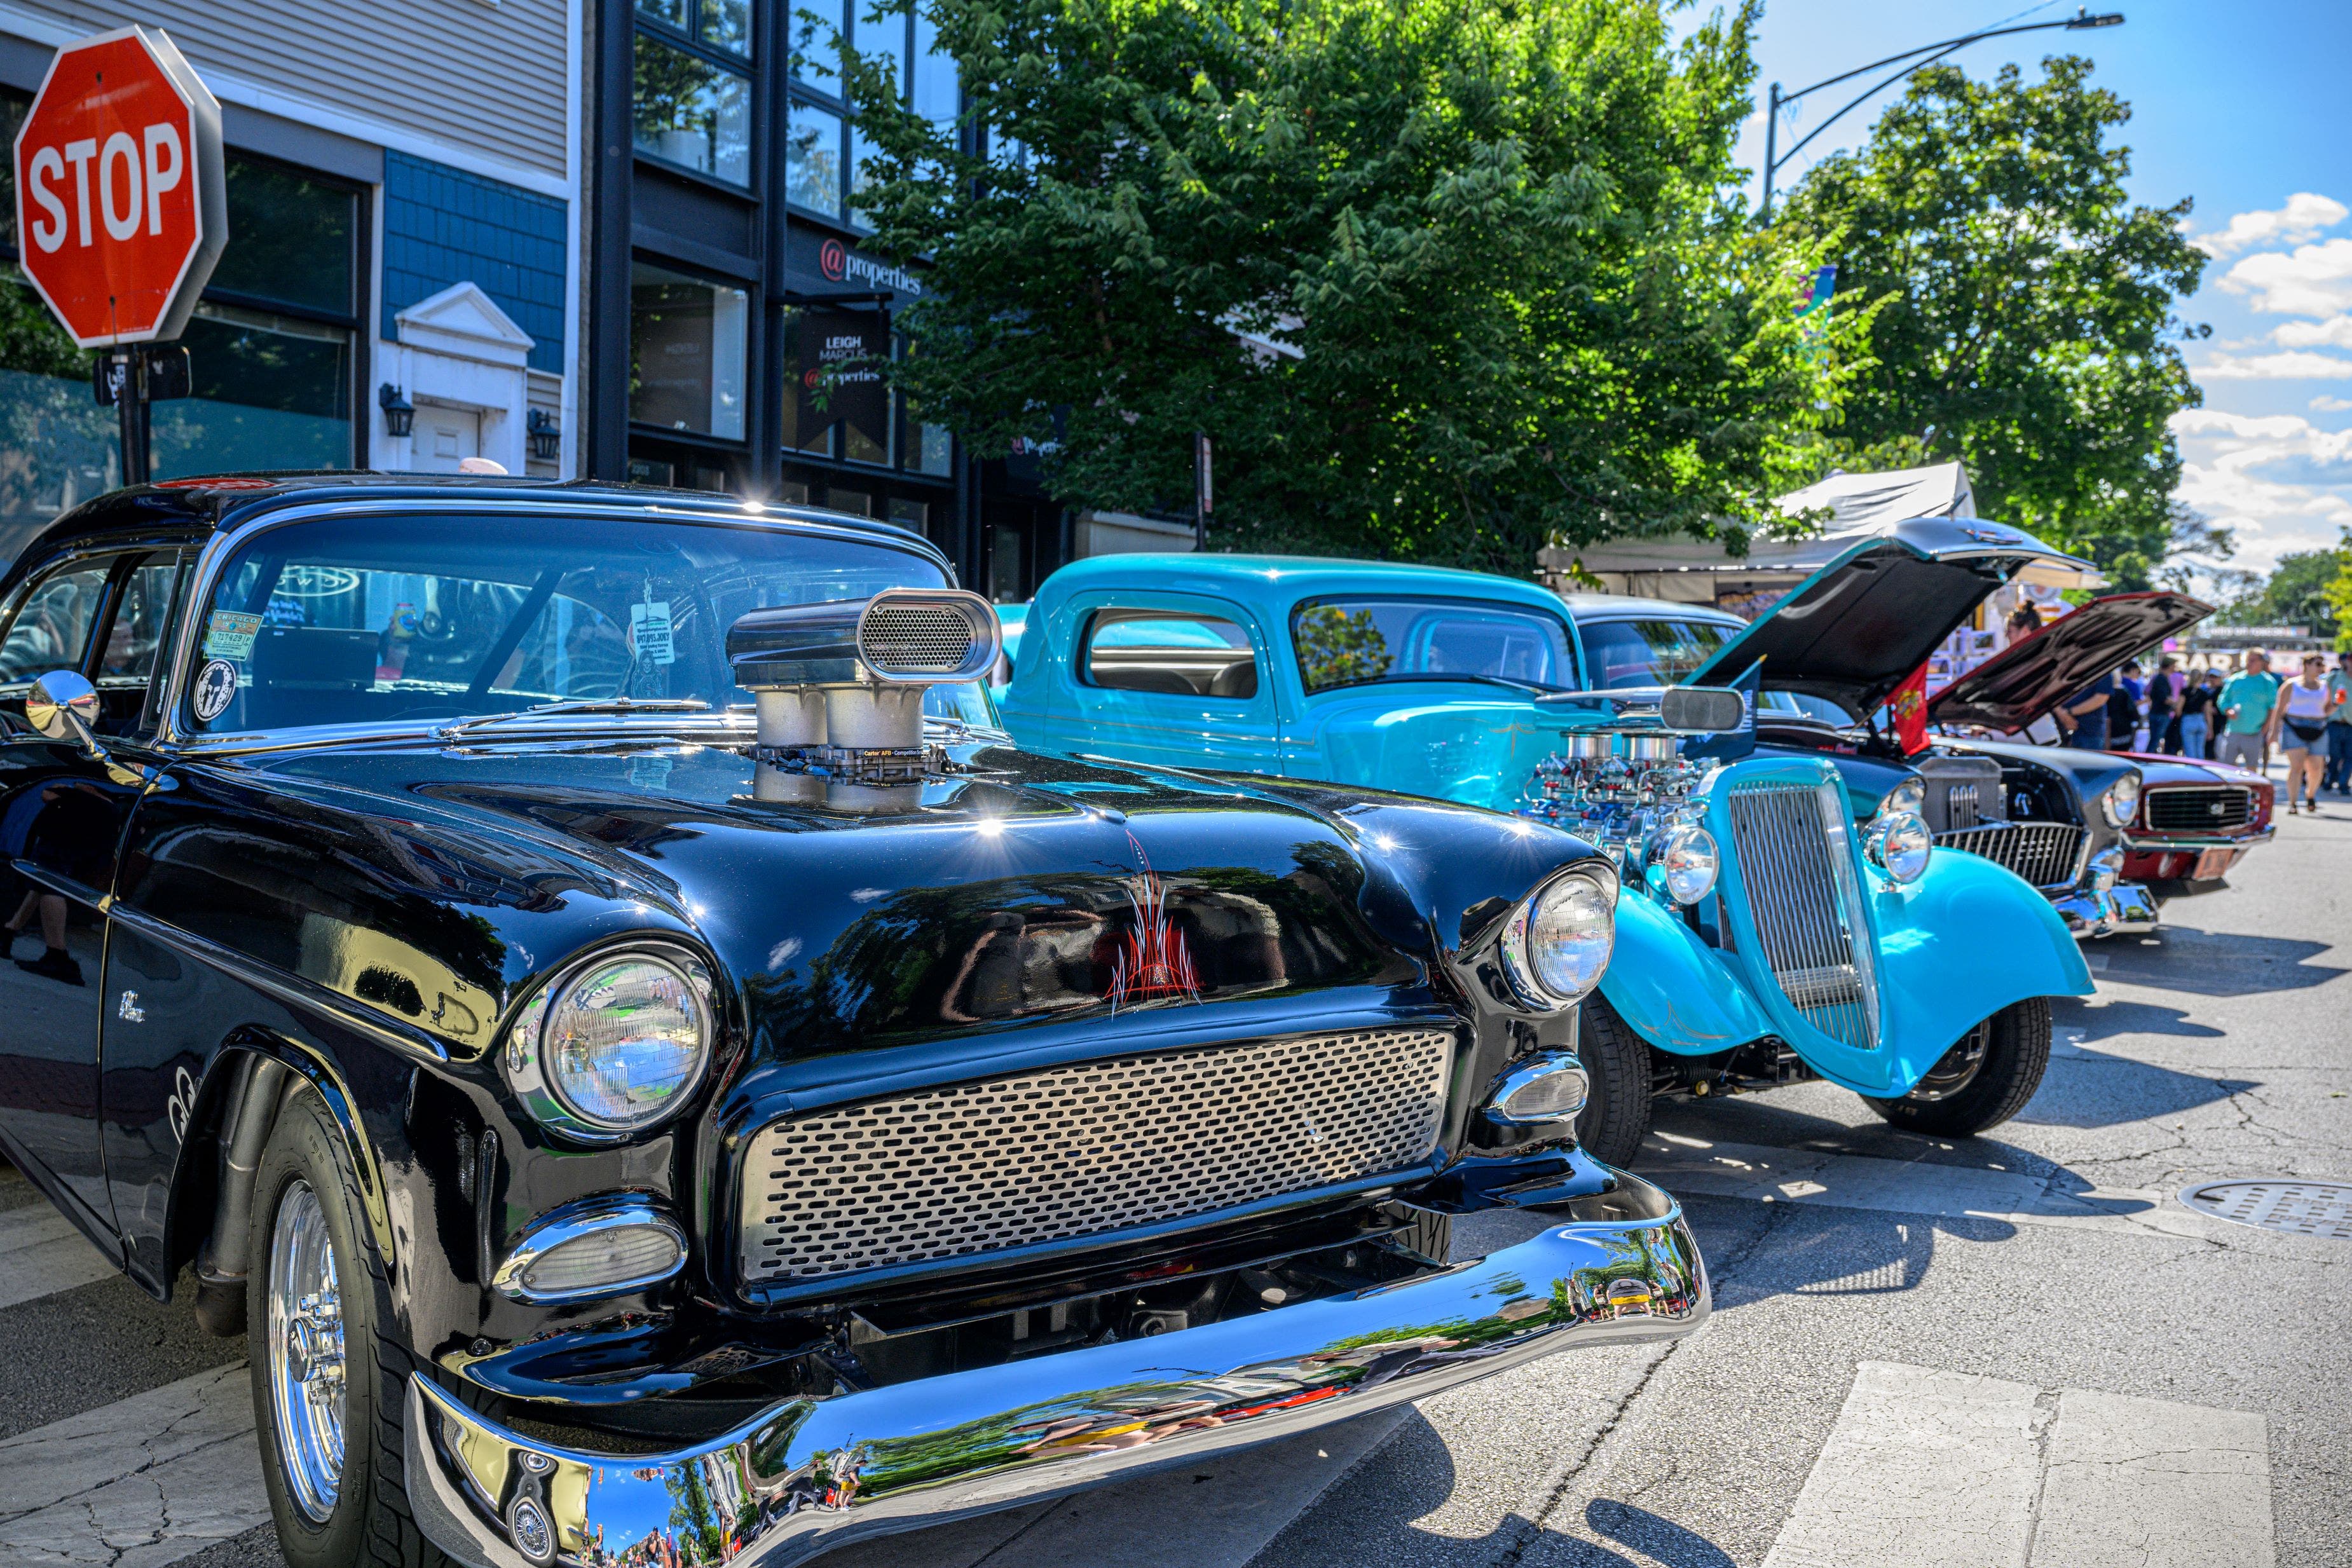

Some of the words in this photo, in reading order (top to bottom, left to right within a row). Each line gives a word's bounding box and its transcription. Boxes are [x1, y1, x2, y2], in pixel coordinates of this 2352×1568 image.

[30, 122, 183, 253] STOP
[821, 238, 921, 295] @properties
[826, 336, 861, 349] LEIGH
[217, 614, 257, 624] CHICAGO
